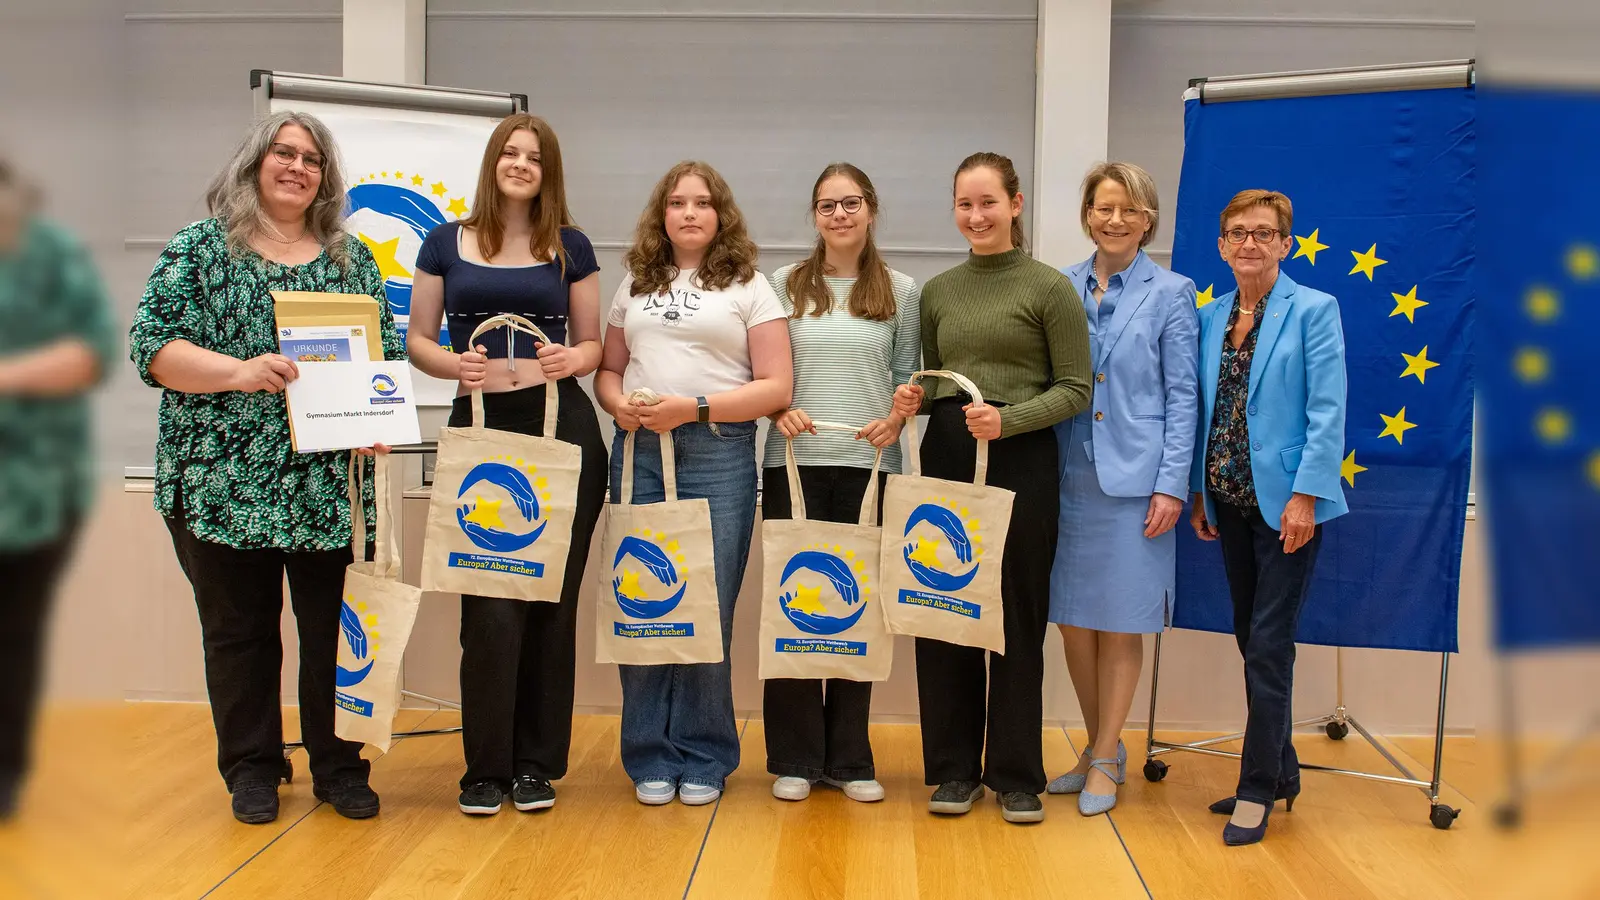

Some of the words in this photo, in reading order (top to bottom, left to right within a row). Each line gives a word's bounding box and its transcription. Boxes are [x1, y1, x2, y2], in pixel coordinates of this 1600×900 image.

[293, 343, 338, 353] URKUNDE
[457, 558, 489, 569] Europa?
[490, 562, 509, 571] Aber
[509, 565, 536, 575] sicher!
[905, 595, 933, 606] Europa?
[933, 600, 950, 609] Aber
[950, 604, 973, 616] sicher!
[619, 628, 643, 638] Europa?
[783, 643, 814, 653] Europa?
[815, 644, 833, 652] Aber
[833, 645, 859, 654] sicher!
[342, 701, 365, 714] sicher!
